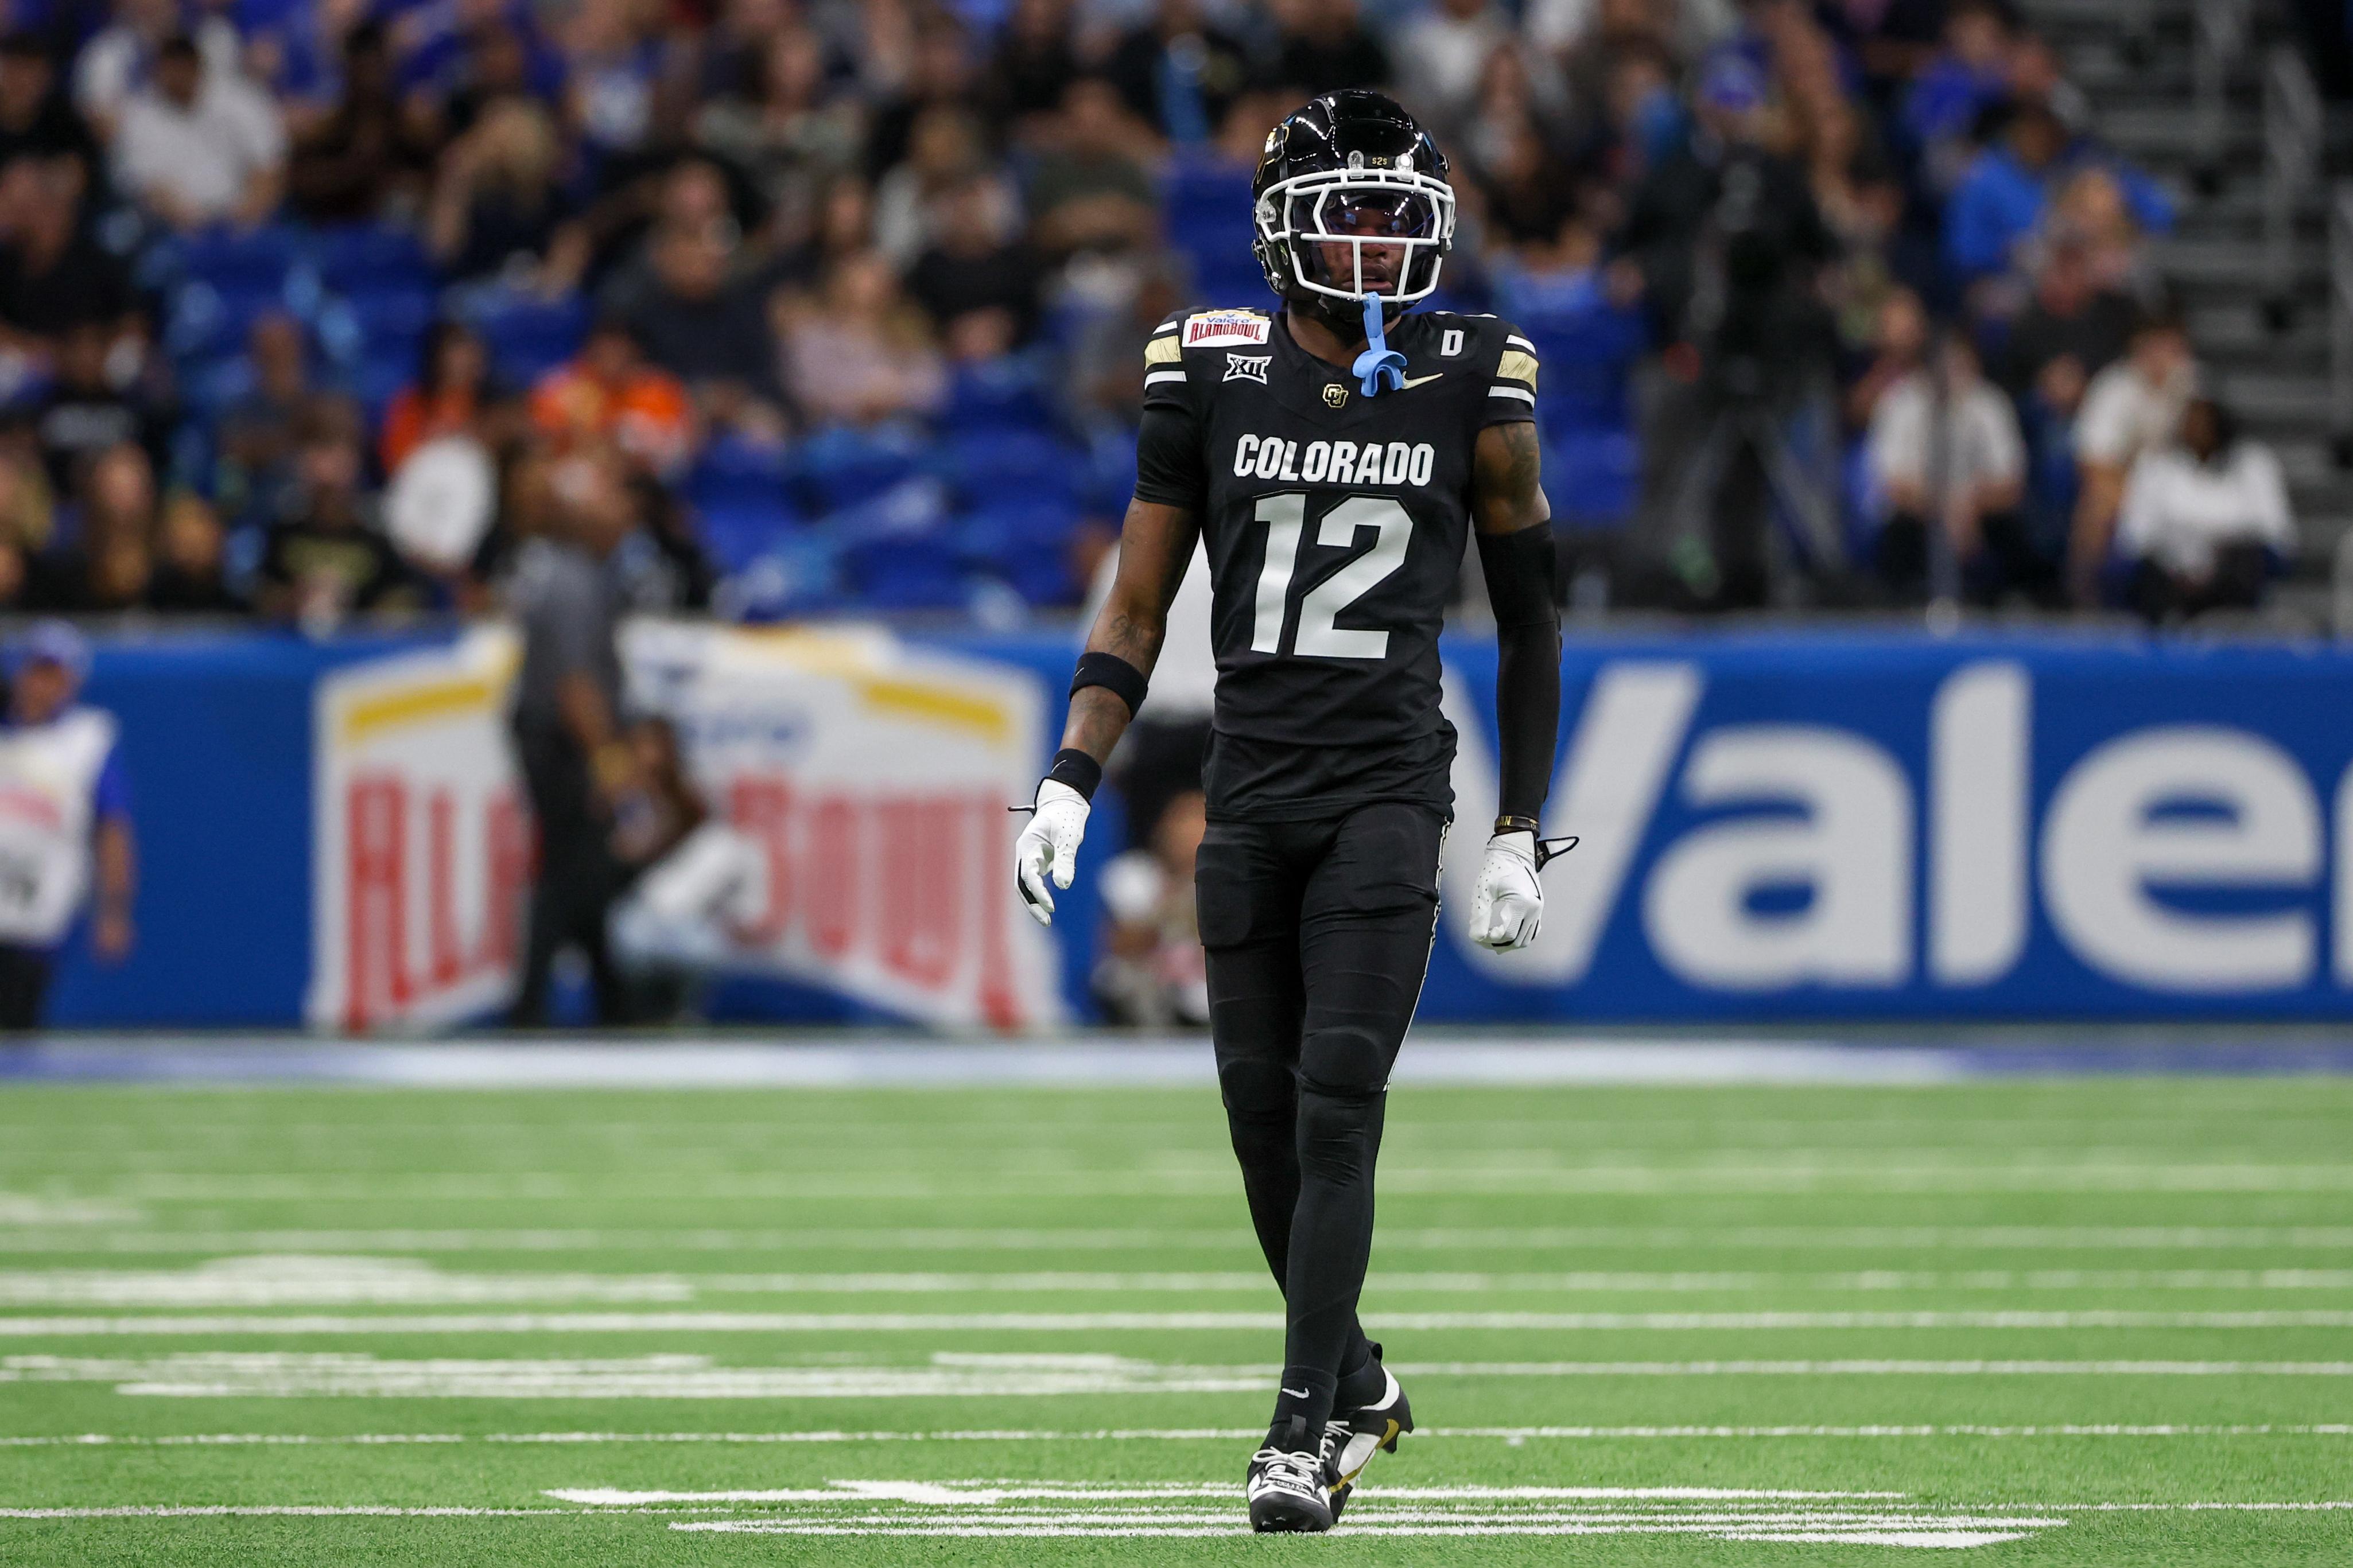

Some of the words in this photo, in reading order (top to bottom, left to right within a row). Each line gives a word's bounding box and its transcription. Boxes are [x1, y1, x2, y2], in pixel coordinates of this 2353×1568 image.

[1233, 434, 1435, 487] COLORADO
[1250, 492, 1414, 659] 12
[1429, 659, 2353, 997] Vale
